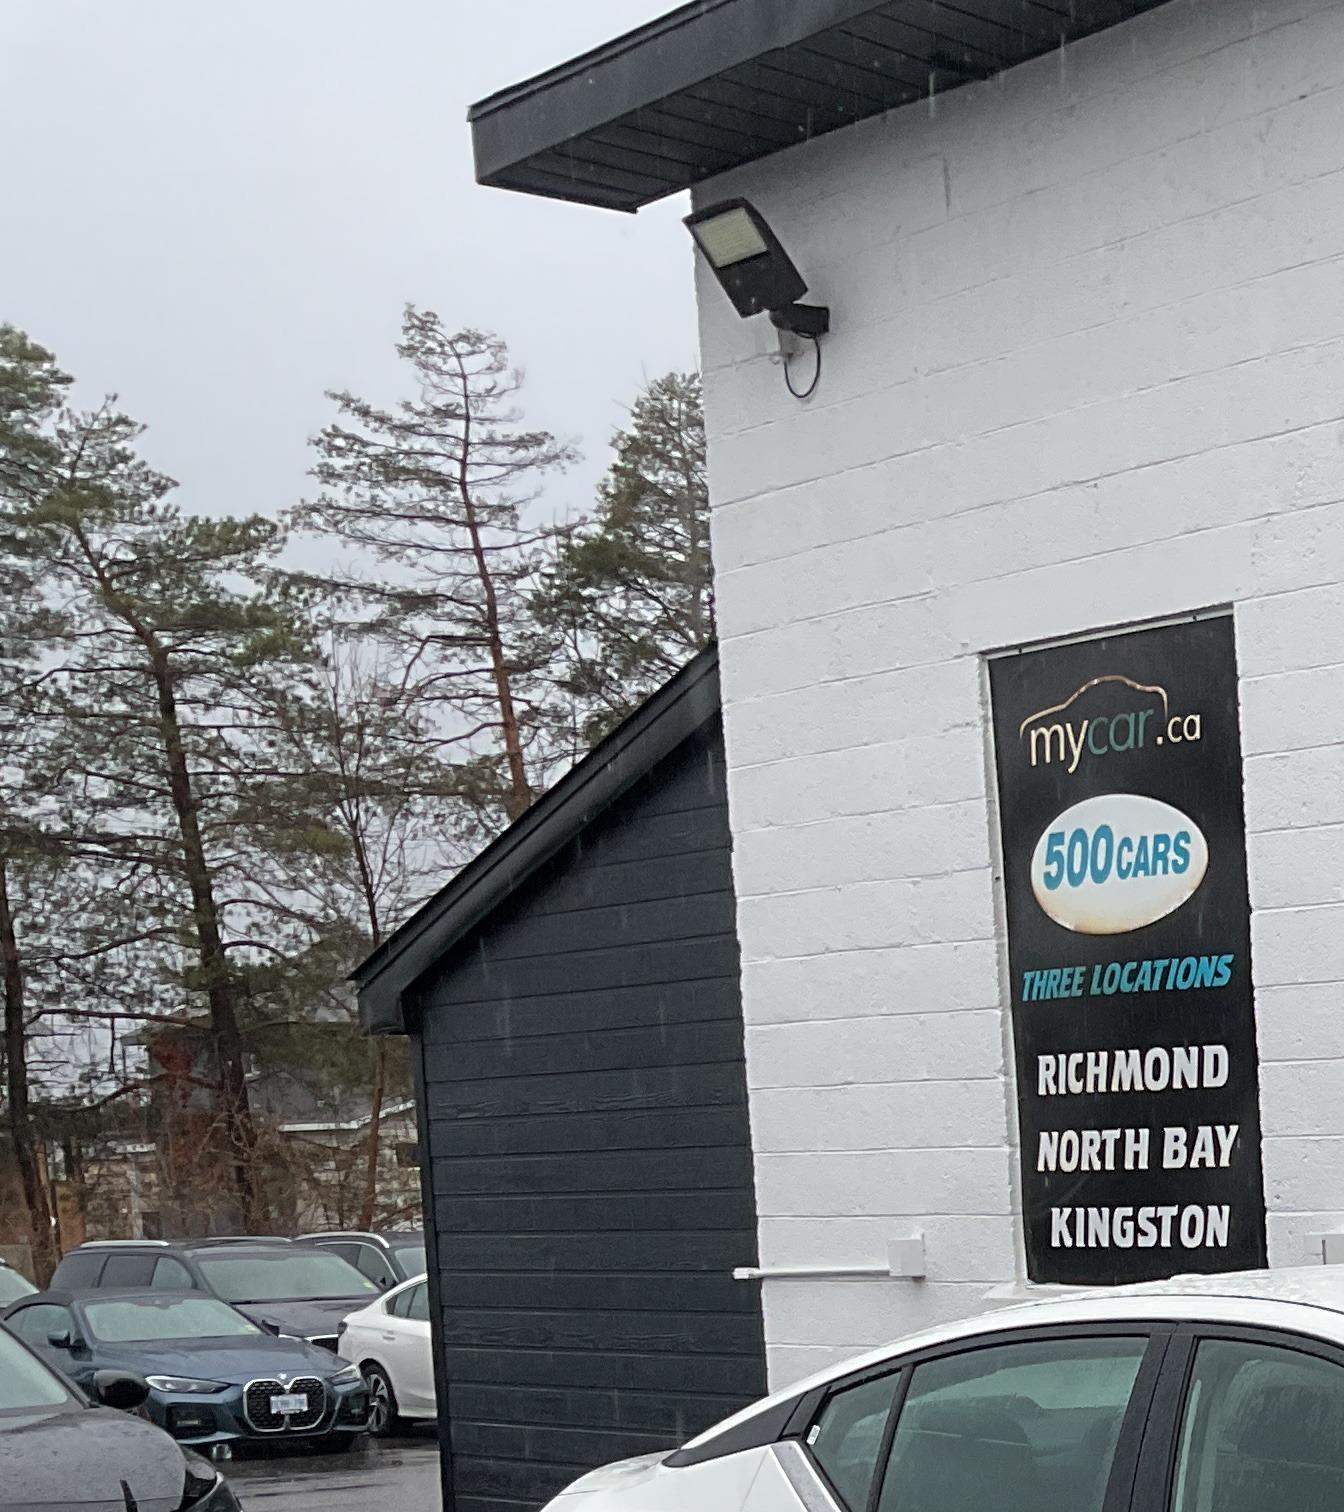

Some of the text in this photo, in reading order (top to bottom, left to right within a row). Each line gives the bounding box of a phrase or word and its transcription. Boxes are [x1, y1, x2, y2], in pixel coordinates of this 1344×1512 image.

[1030, 709, 1201, 773] mycar.ca
[1022, 954, 1234, 1001] THREE LOCATIONS
[1038, 1044, 1229, 1096] RICHMOND
[1037, 1124, 1239, 1172] NORTH BAY
[1051, 1204, 1230, 1248] KINGSTON
